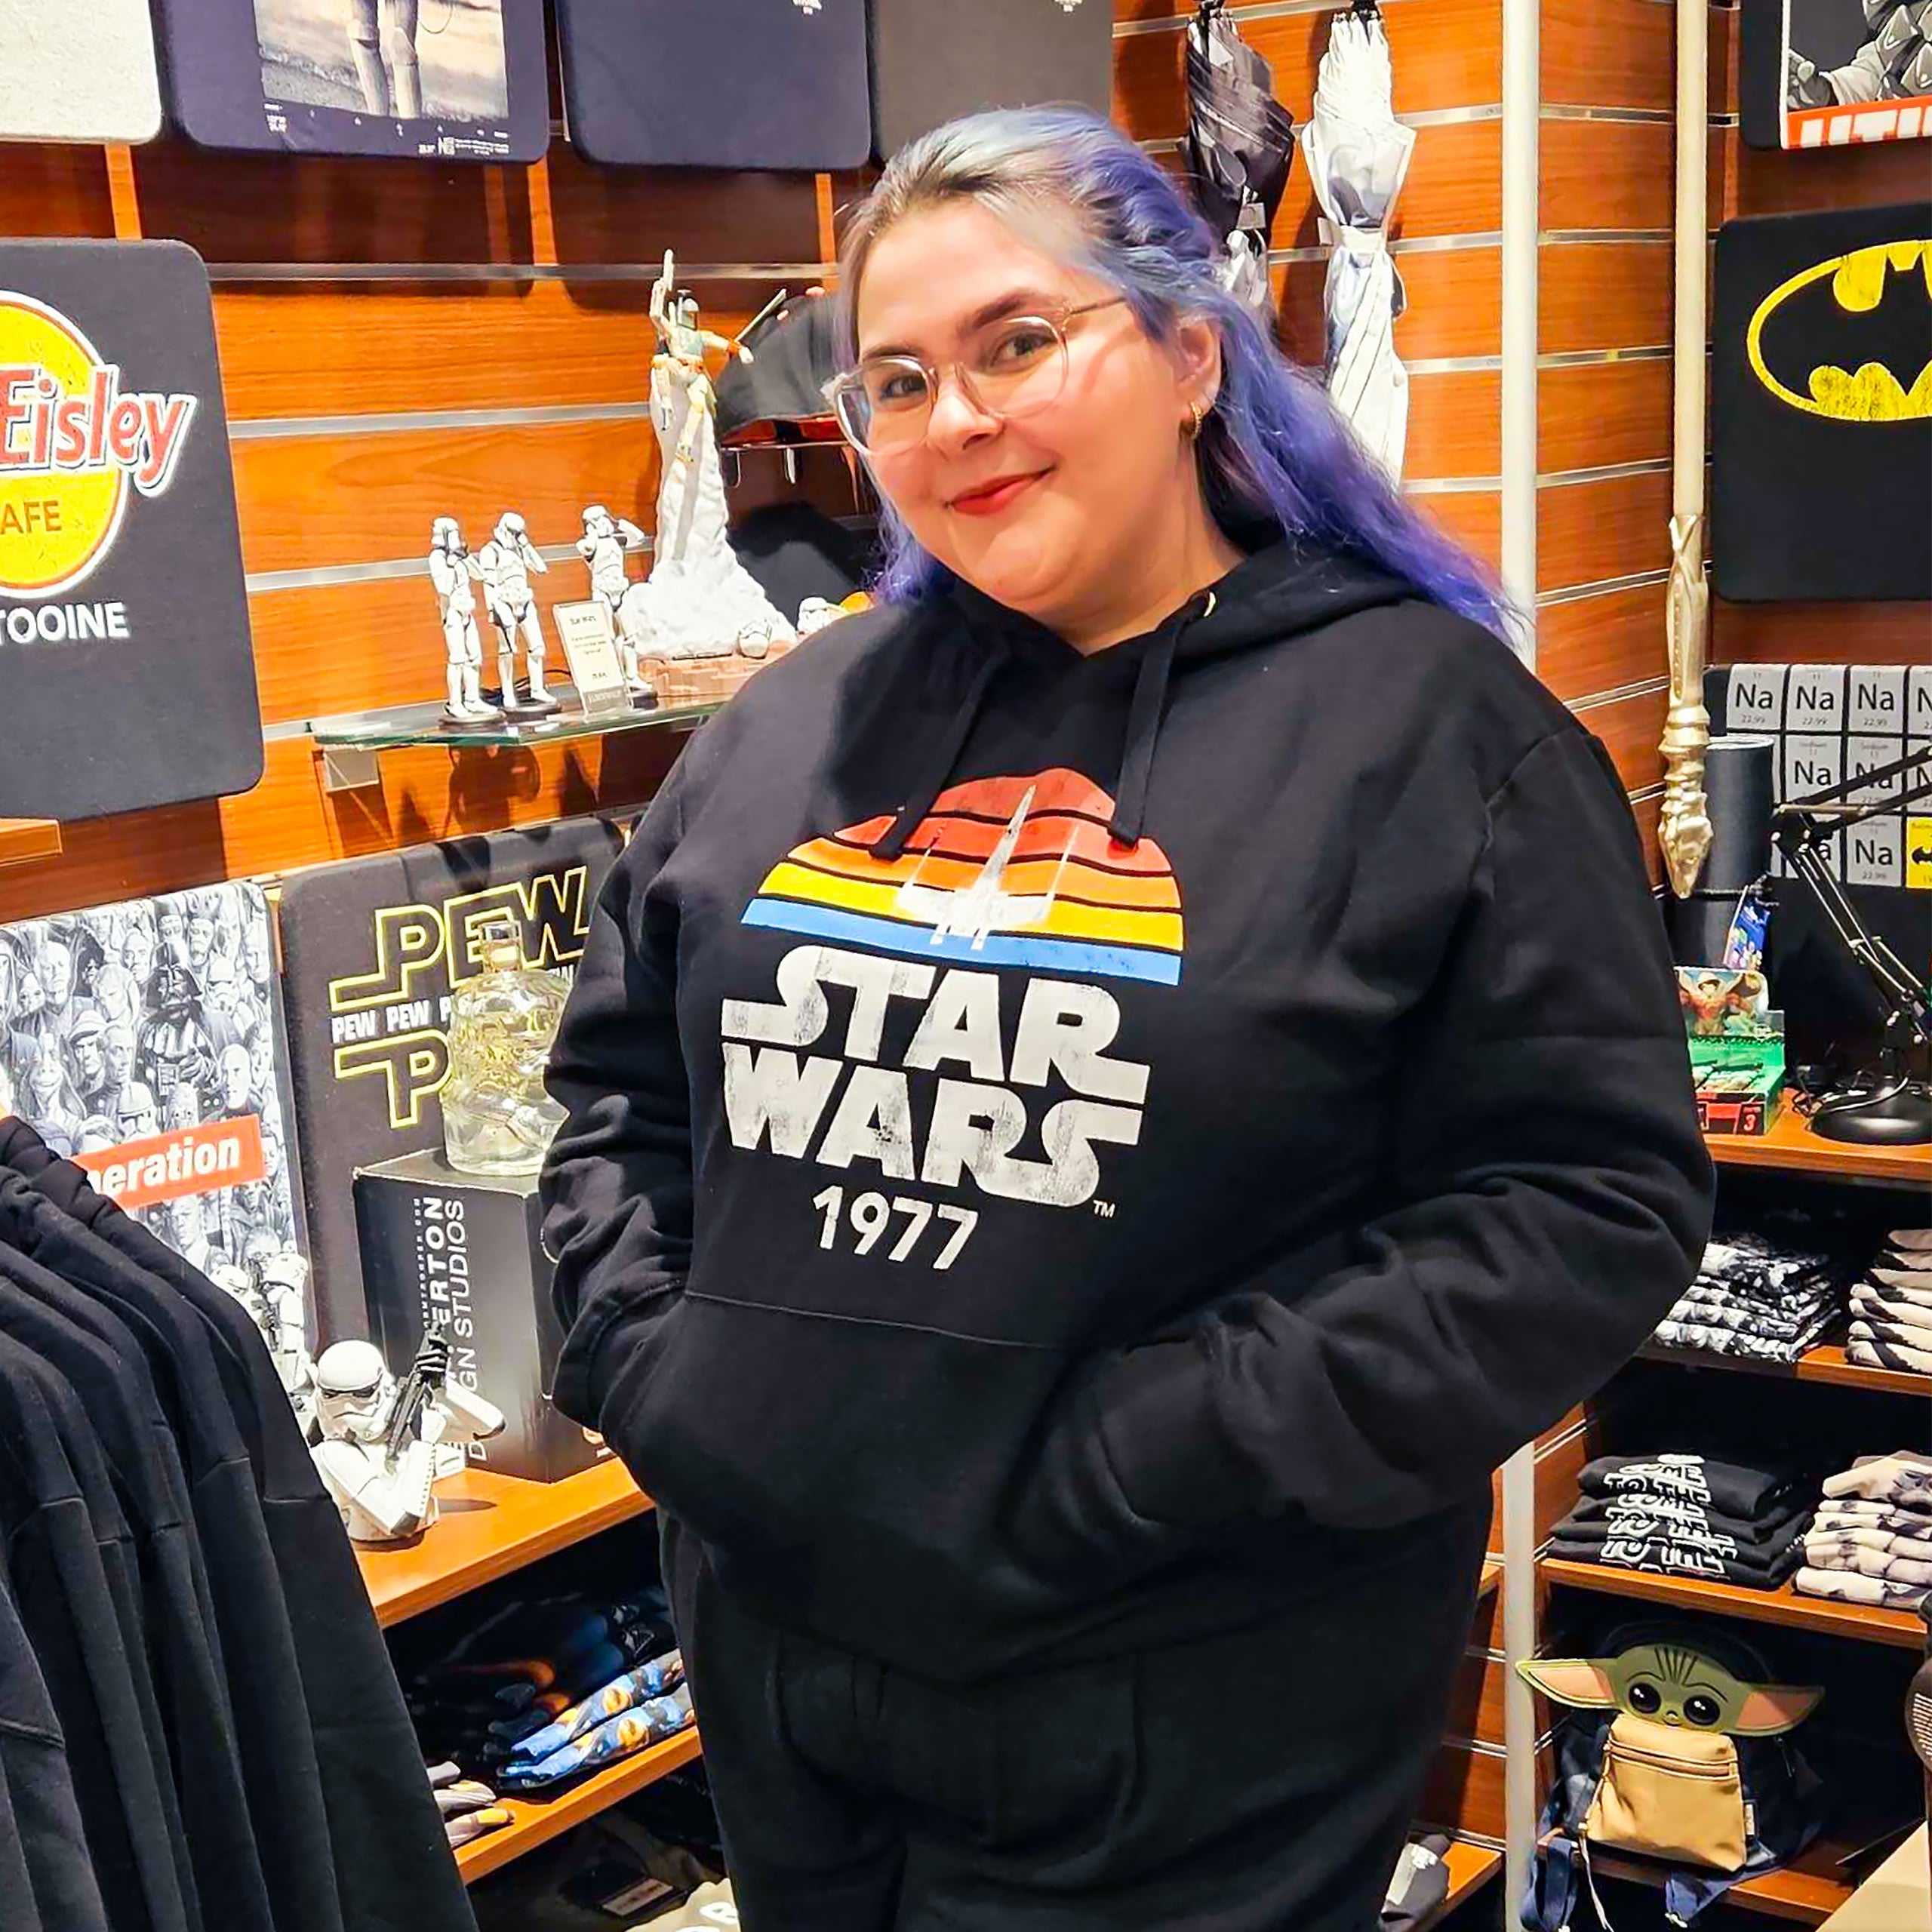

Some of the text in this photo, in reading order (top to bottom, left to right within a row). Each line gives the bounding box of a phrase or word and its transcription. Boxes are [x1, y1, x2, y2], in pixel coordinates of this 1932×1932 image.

[1736, 683, 1774, 709] Na
[1796, 685, 1834, 710] Na
[1857, 683, 1894, 711] Na
[1795, 760, 1832, 786] Na
[1855, 839, 1893, 866] Na
[328, 866, 589, 1012] PEW
[332, 1010, 377, 1044] PEW
[386, 1000, 431, 1032] PEW
[721, 945, 1150, 1104] STAR
[721, 1041, 1143, 1208] WARS
[1093, 1200, 1115, 1218] TM
[812, 1186, 978, 1271] 1977
[444, 1199, 474, 1339] STUDIOS
